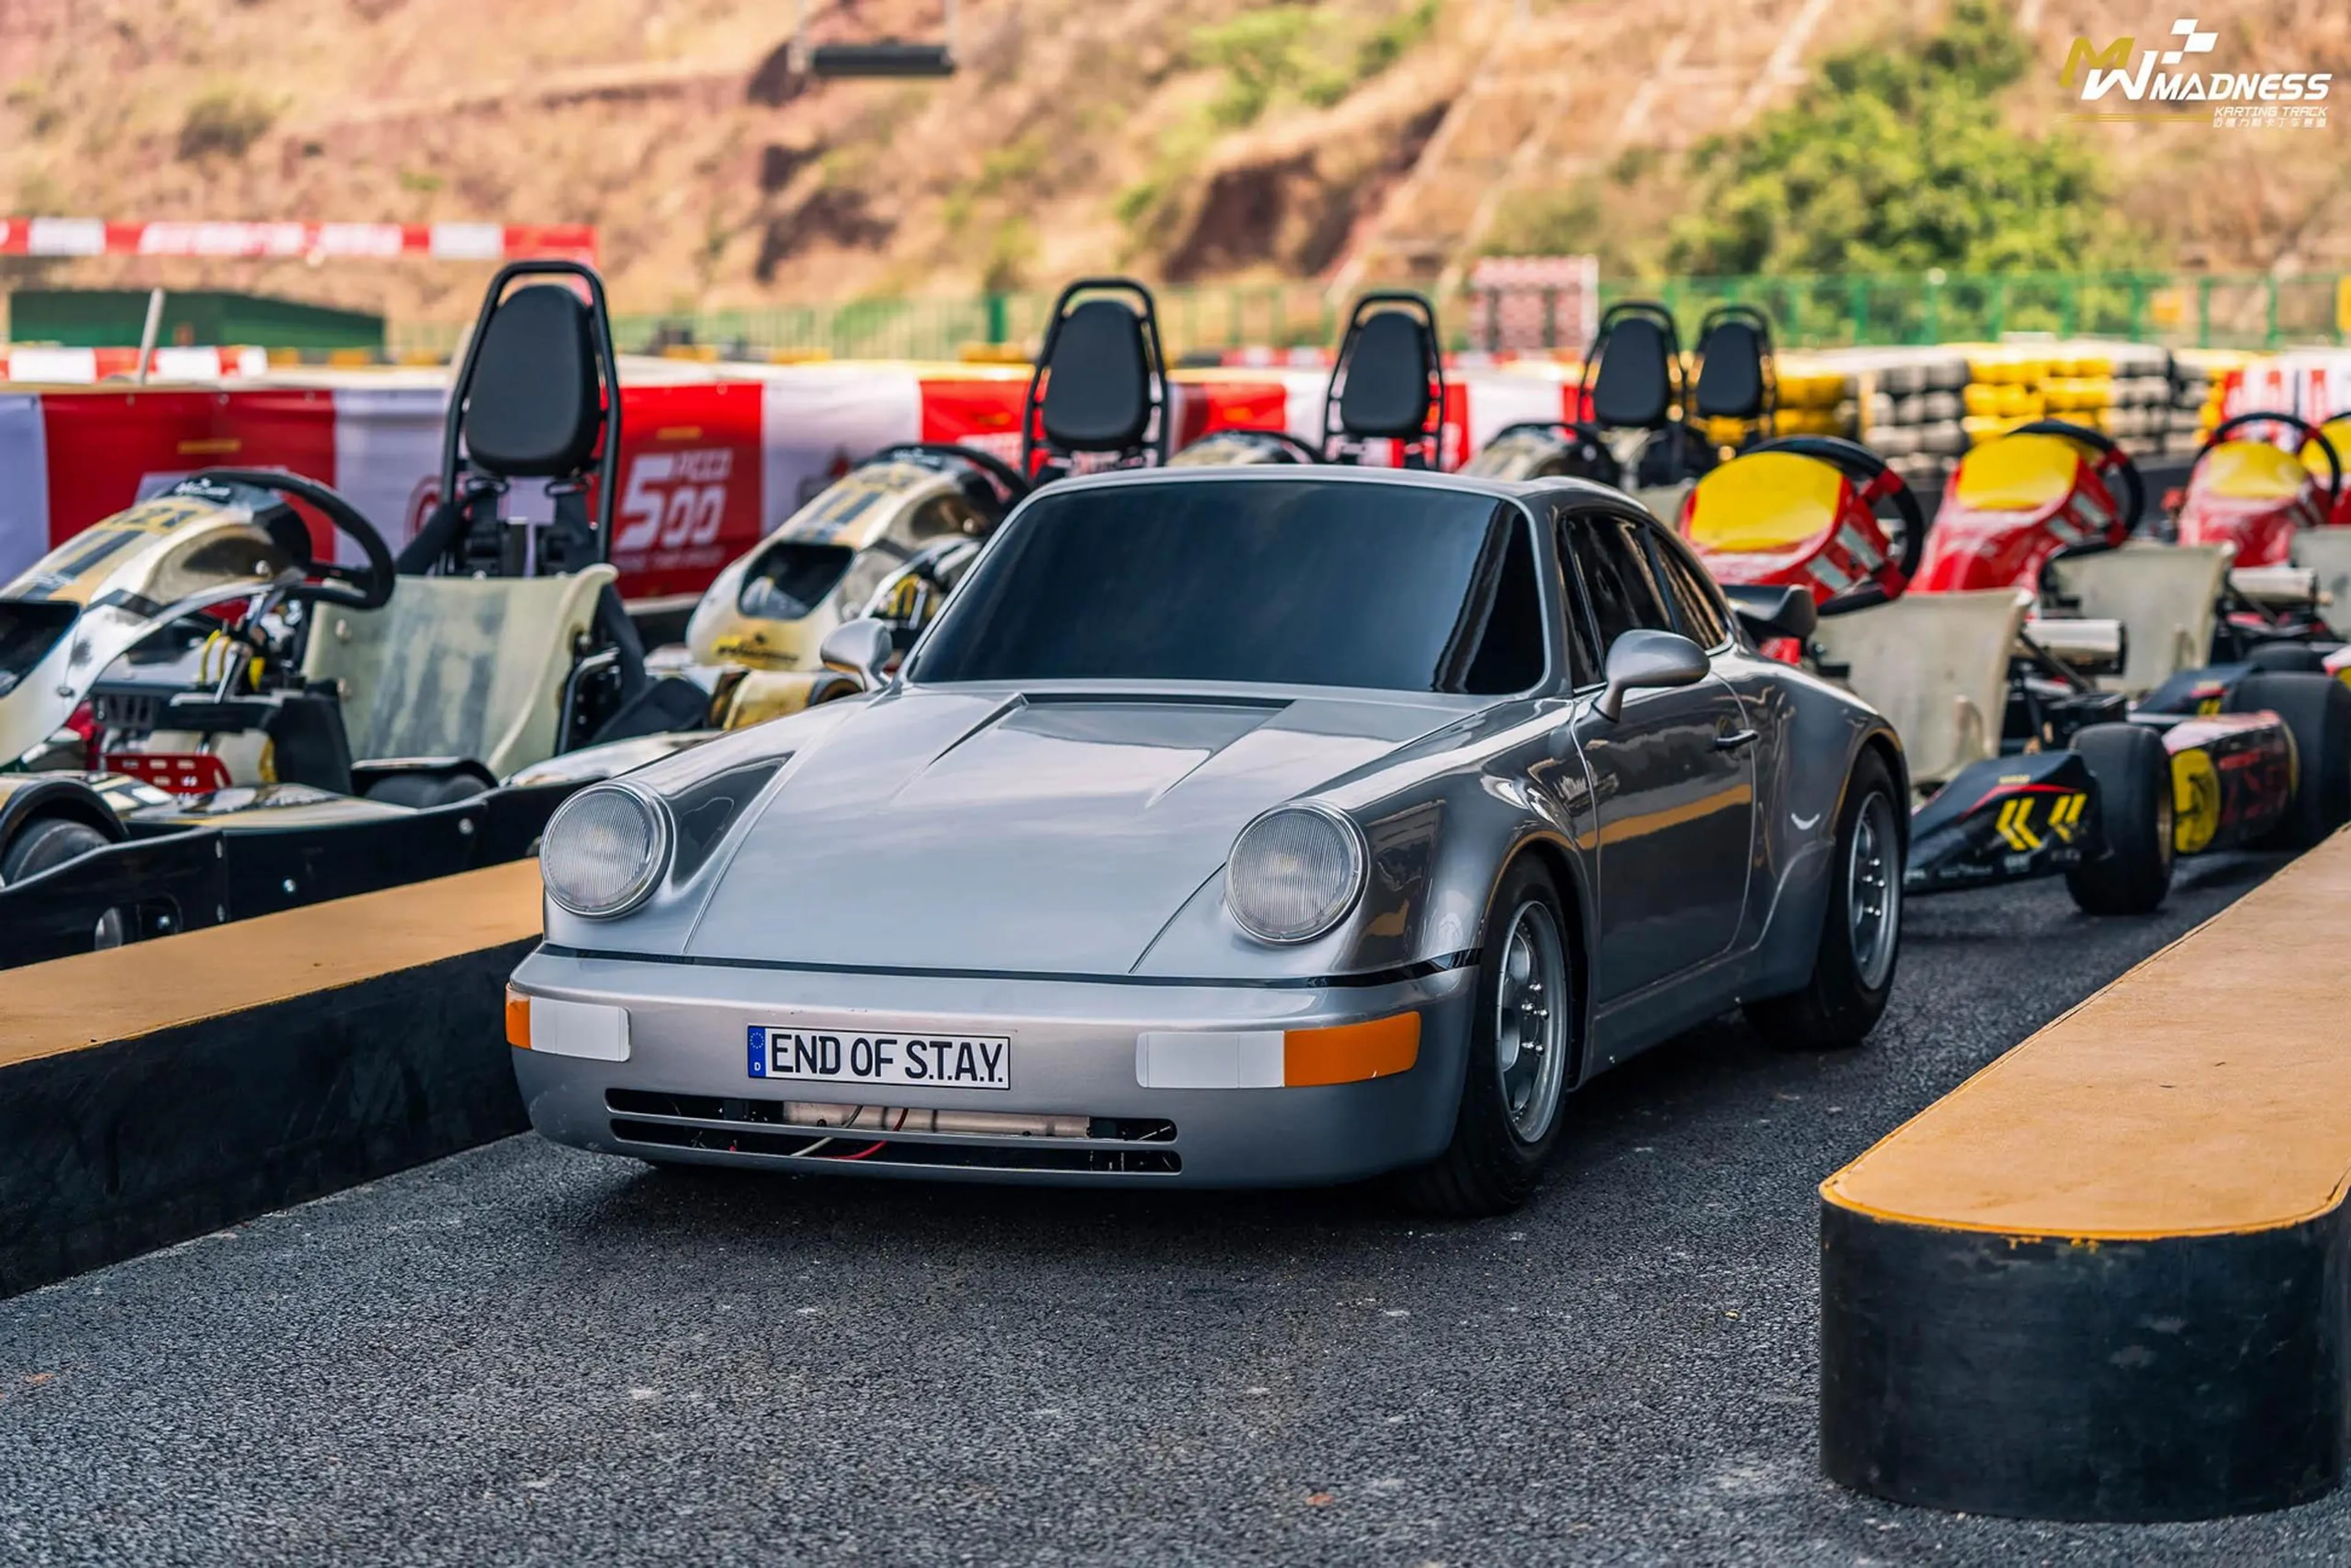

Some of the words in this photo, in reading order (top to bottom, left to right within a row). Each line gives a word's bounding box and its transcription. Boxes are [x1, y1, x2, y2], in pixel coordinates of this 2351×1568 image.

[754, 1062, 761, 1071] D
[771, 1033, 841, 1075] END
[850, 1037, 898, 1078] OF
[904, 1040, 1003, 1083] S.T.A.Y.
